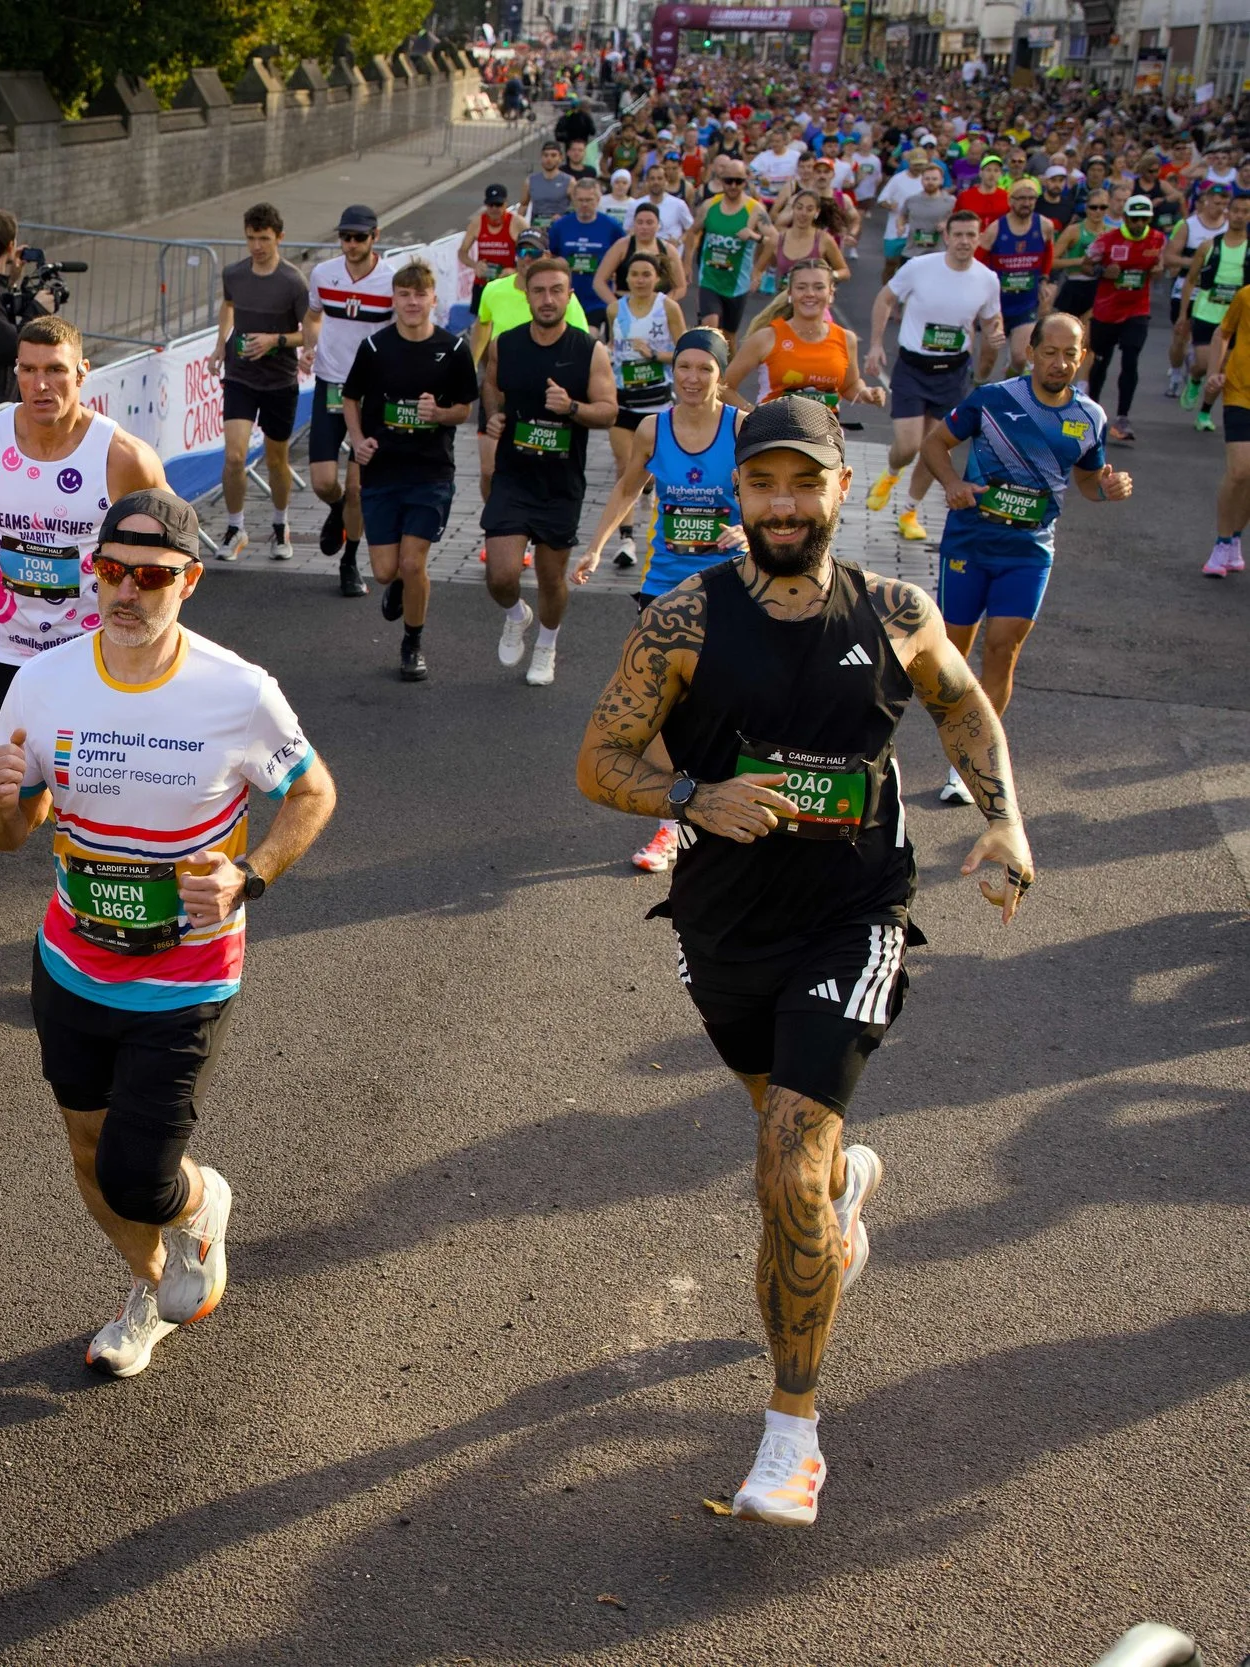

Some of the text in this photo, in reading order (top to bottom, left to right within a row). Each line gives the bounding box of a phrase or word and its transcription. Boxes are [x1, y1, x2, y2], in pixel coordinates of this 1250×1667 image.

[706, 232, 741, 250] SPCC
[184, 355, 224, 405] BREC
[397, 406, 416, 417] FINL
[530, 427, 557, 439] JOSH
[527, 435, 557, 448] 21149
[666, 485, 724, 495] Alzheimer's
[676, 494, 715, 505] Society
[994, 490, 1038, 508] ANDREA
[999, 502, 1027, 517] 2143
[673, 518, 715, 530] LOUISE
[19, 531, 56, 544] CHARITY
[674, 529, 712, 541] 22573
[26, 544, 48, 553] CARDIFF
[22, 556, 53, 571] TOM
[18, 568, 59, 584] 19330
[80, 730, 205, 752] ymchwil canser
[77, 748, 126, 763] cymru
[788, 752, 846, 765] CARDIFF HALF
[75, 765, 196, 786] cancer research
[76, 781, 121, 795] wales
[779, 790, 826, 814] 094
[96, 864, 150, 874] CARDIFF HALF
[90, 882, 144, 902] OWEN
[91, 899, 148, 921] 18662
[152, 939, 175, 950] 18662
